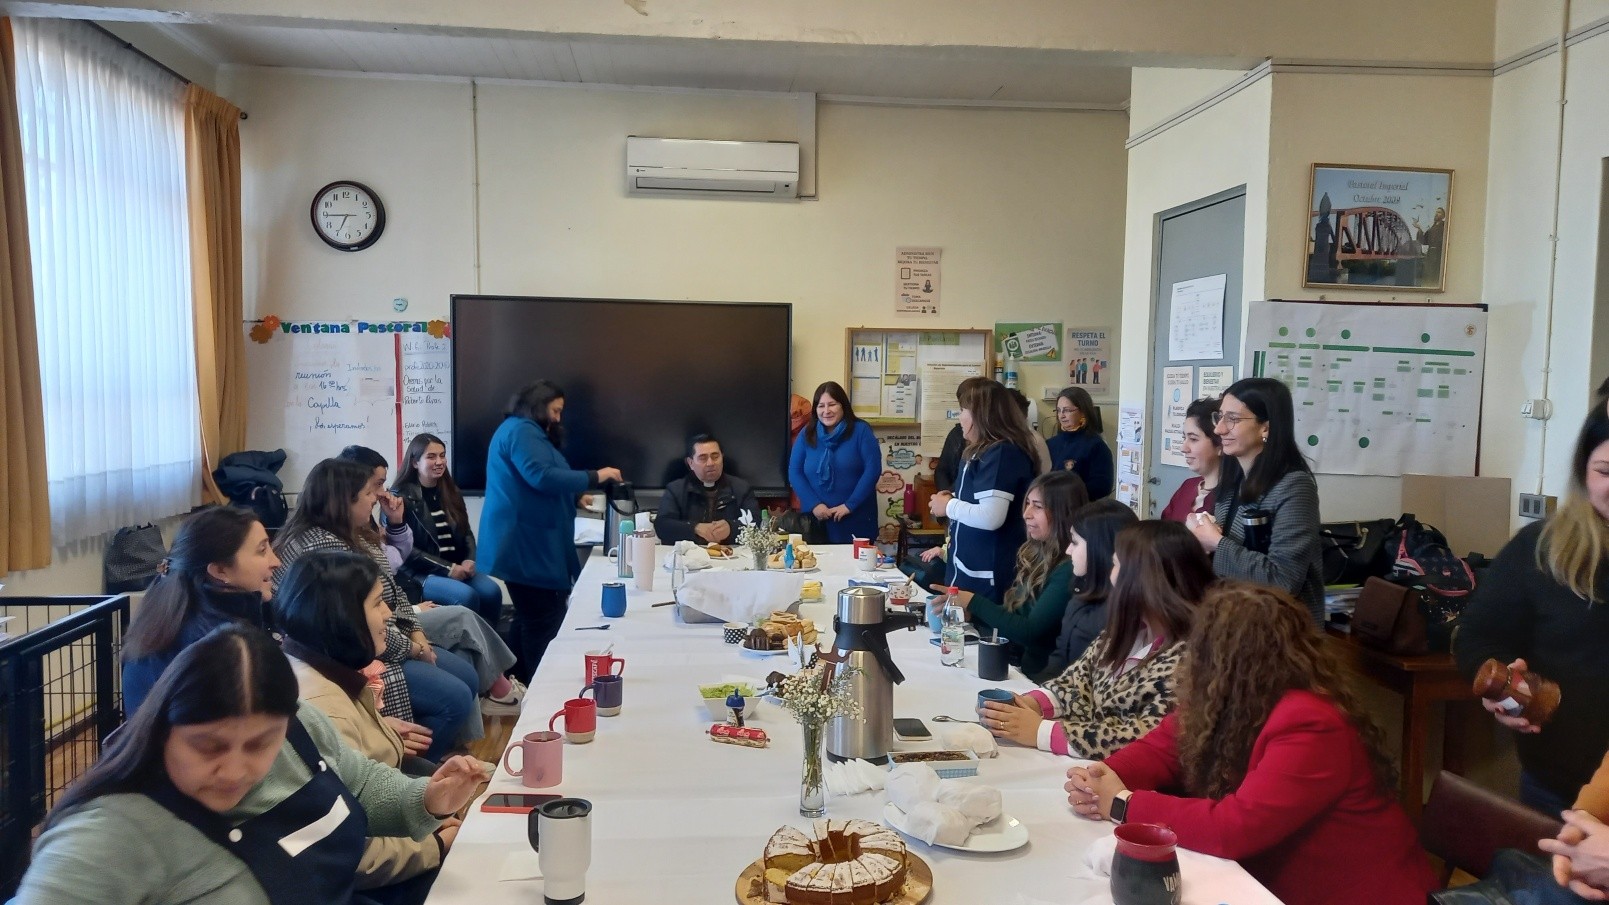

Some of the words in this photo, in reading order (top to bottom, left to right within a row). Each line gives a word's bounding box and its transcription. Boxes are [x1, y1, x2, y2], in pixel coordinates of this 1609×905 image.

[281, 322, 350, 333] Ventana
[358, 321, 427, 333] Pastoral
[295, 370, 332, 379] reunión
[307, 397, 341, 414] Capilla
